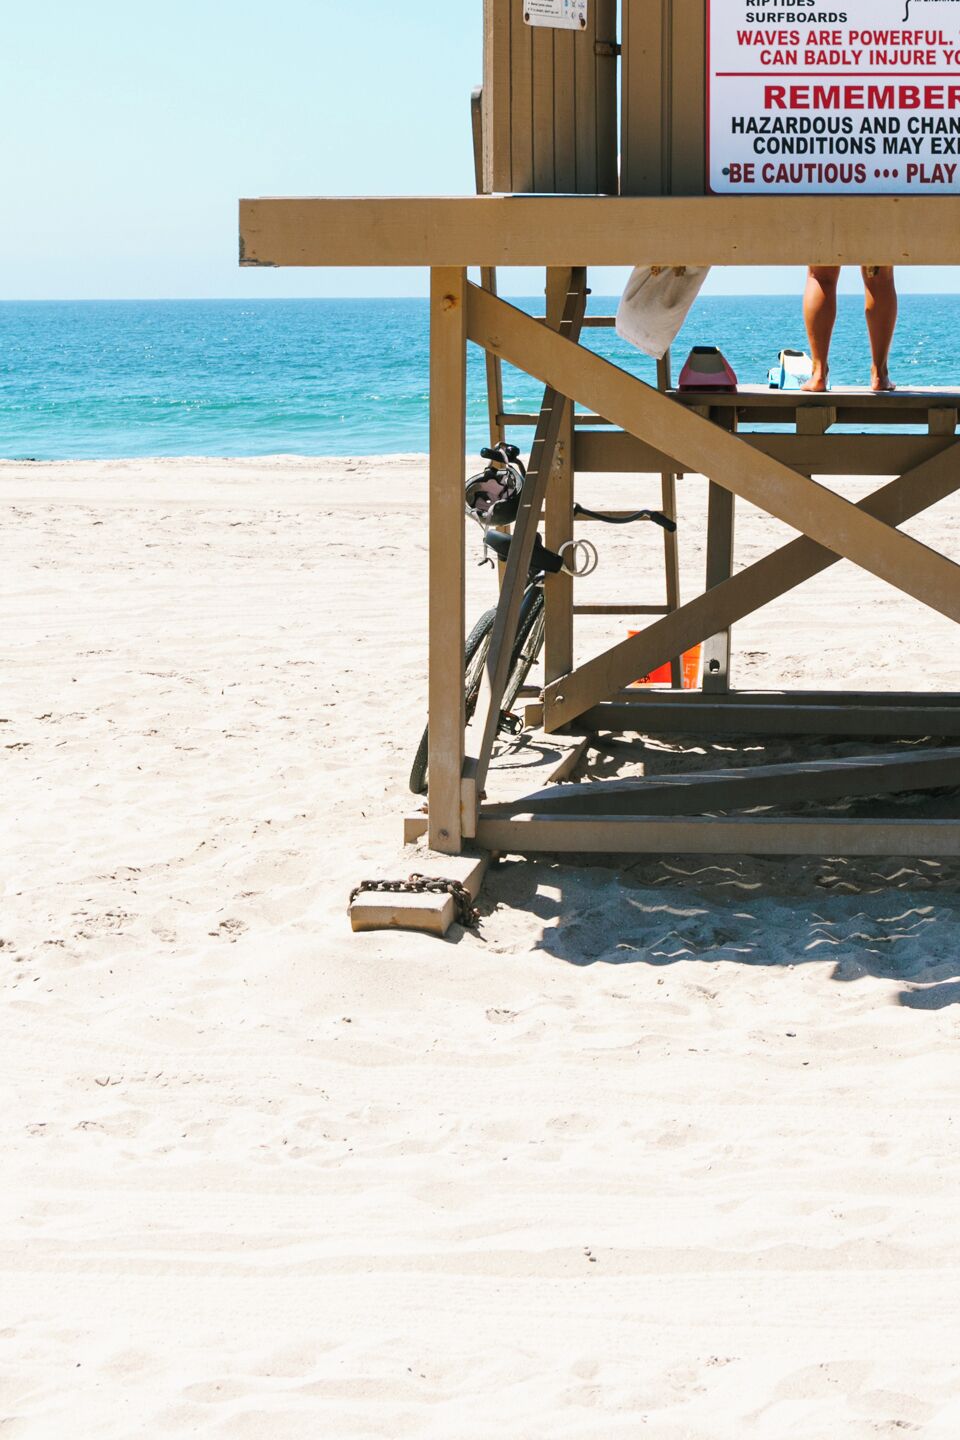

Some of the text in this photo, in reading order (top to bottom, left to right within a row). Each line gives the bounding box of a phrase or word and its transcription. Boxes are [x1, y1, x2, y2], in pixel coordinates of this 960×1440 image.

[745, 12, 848, 23] SURFBOARDS
[736, 30, 801, 46] WAVES
[805, 30, 843, 46] ARE
[848, 30, 954, 46] POWERFUL.
[759, 50, 798, 66] CAN
[804, 50, 863, 66] BADLY
[869, 50, 937, 66] INJURE
[731, 116, 854, 135] HAZARDOUS
[859, 116, 901, 135] AND
[752, 136, 877, 155] CONDITIONS
[882, 136, 925, 155] MAY
[729, 163, 755, 184] BE
[761, 163, 867, 184] CAUTIOUS
[906, 163, 958, 184] PLAY
